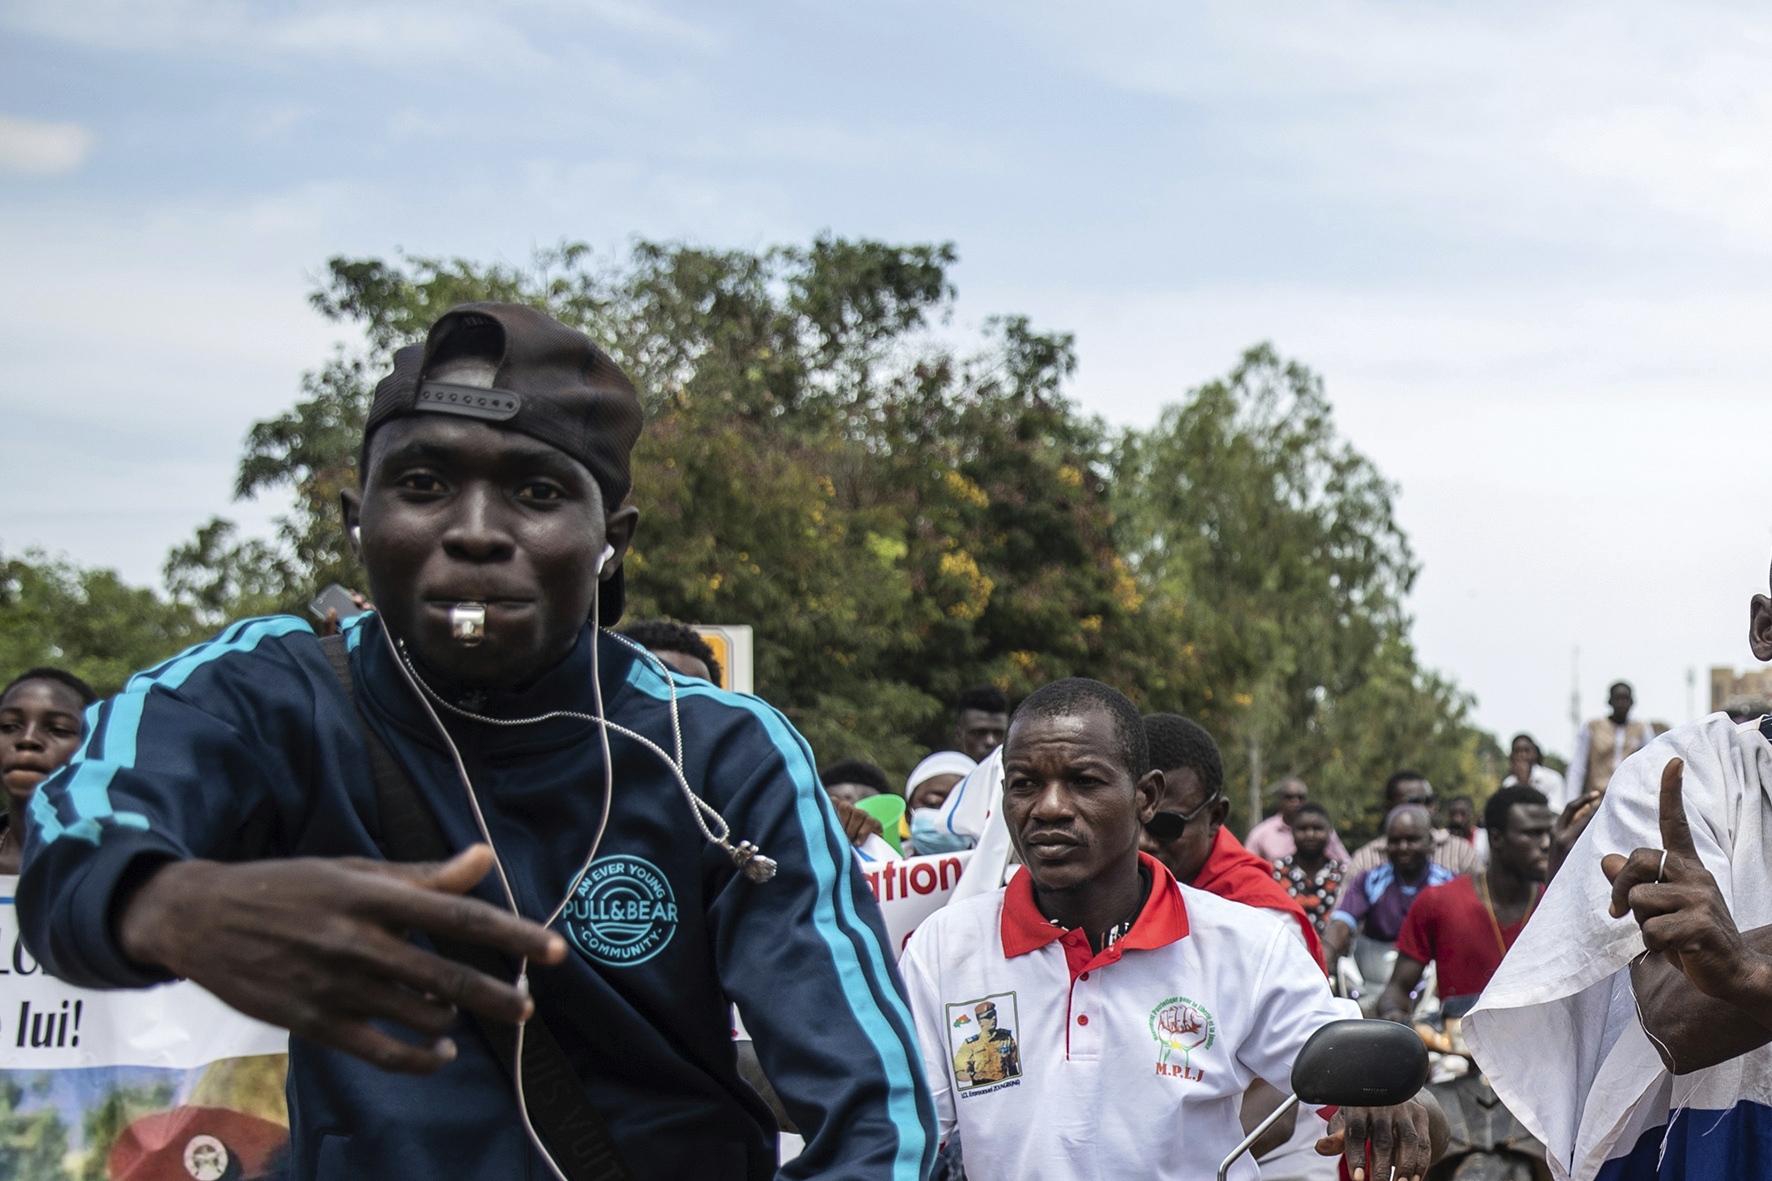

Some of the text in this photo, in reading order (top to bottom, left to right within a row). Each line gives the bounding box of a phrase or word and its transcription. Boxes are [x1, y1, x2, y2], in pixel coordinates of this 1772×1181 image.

[578, 863, 666, 899] AN EVER YOUNG
[563, 900, 678, 923] PULL&BEAR
[16, 999, 83, 1048] lui!
[1156, 1062, 1204, 1082] M.P.L.J
